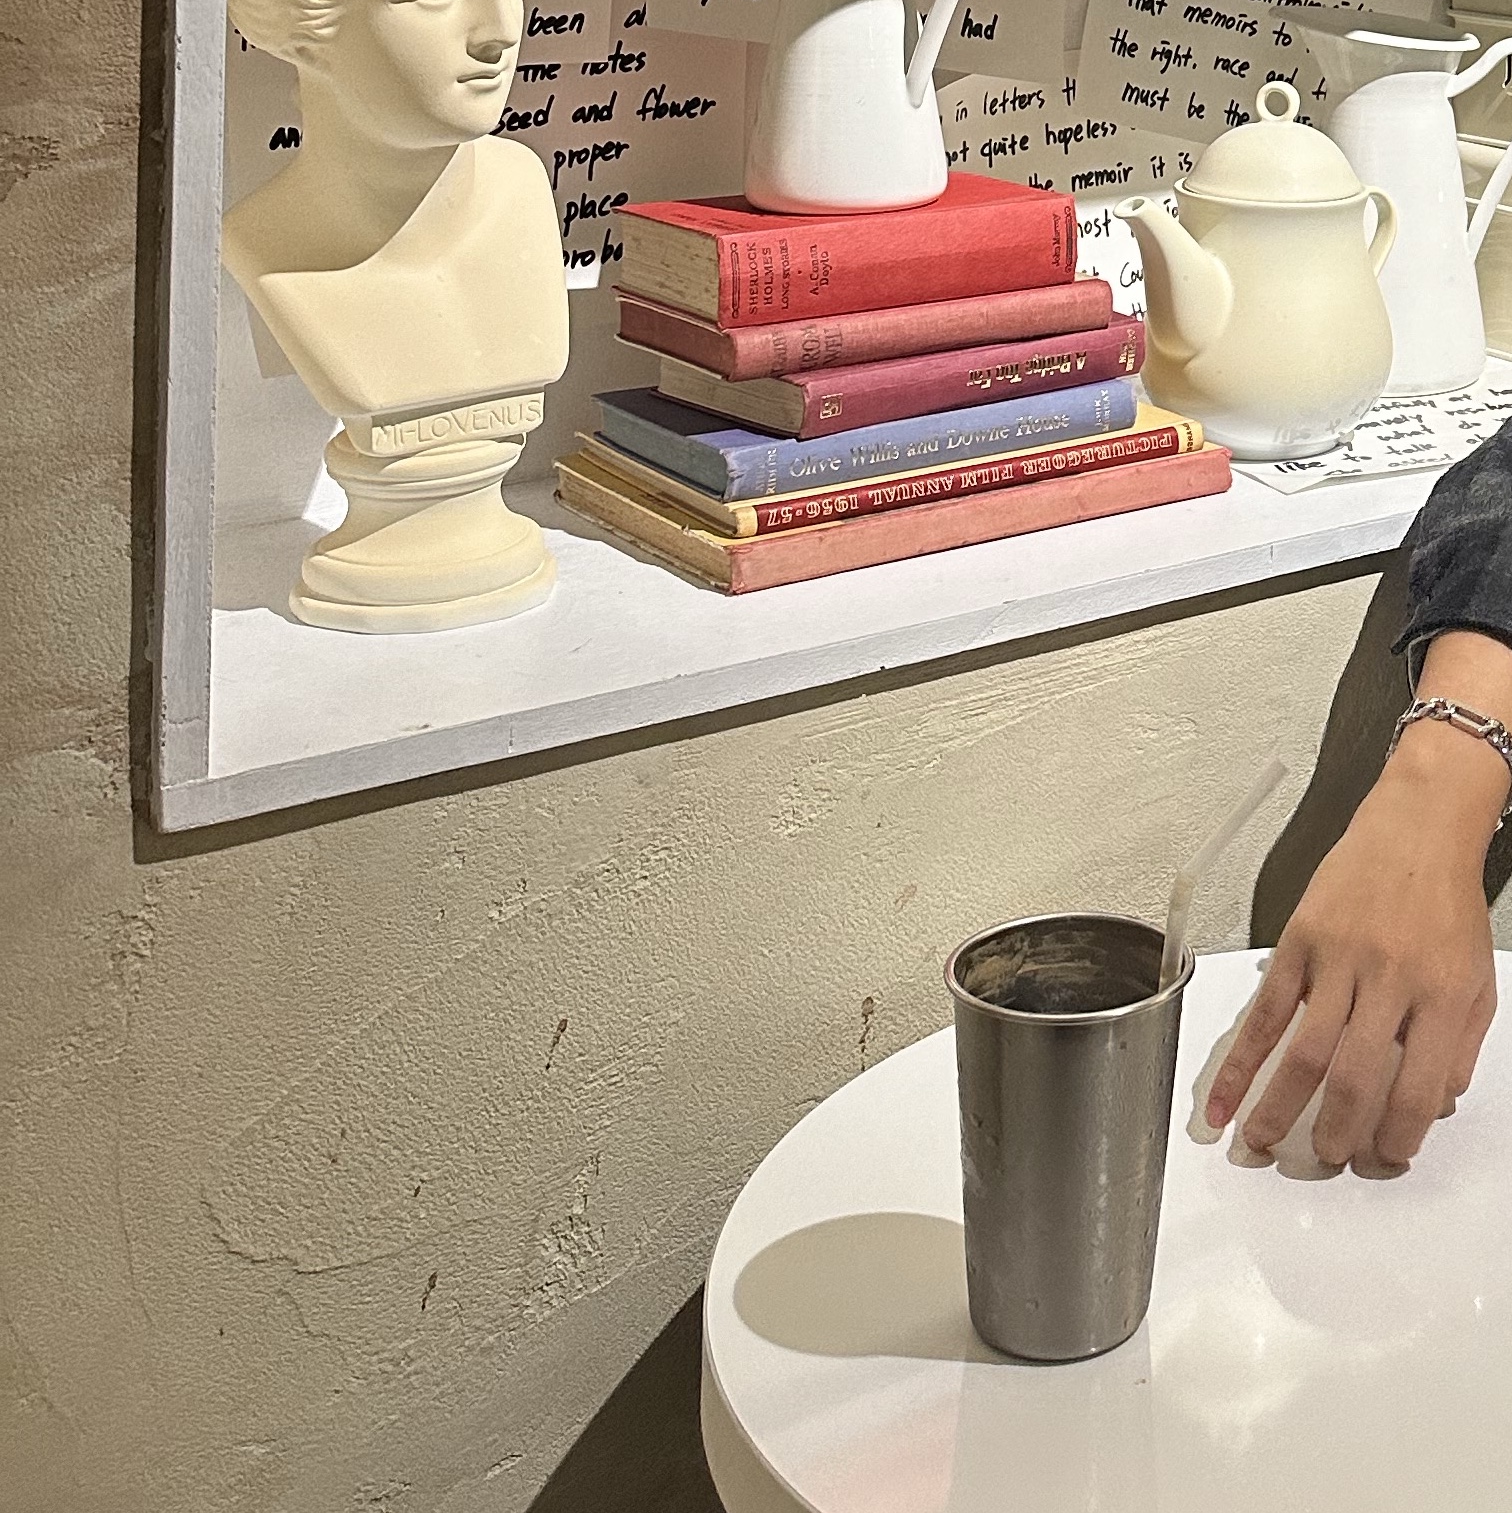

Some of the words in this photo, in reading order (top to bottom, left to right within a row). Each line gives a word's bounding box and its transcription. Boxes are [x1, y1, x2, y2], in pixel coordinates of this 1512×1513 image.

[1184, 6, 1258, 36] memoirs
[1272, 22, 1292, 46] to
[572, 91, 617, 123] and
[636, 84, 716, 121] flower
[1122, 83, 1169, 111] must
[1188, 92, 1205, 119] be
[746, 242, 759, 315] SHERLOCK
[761, 247, 774, 306] HOLMES
[906, 434, 939, 457] and
[1021, 432, 1173, 476] PICTUREGOER
[867, 474, 955, 506] ANNUAL
[959, 462, 1014, 488] FILM
